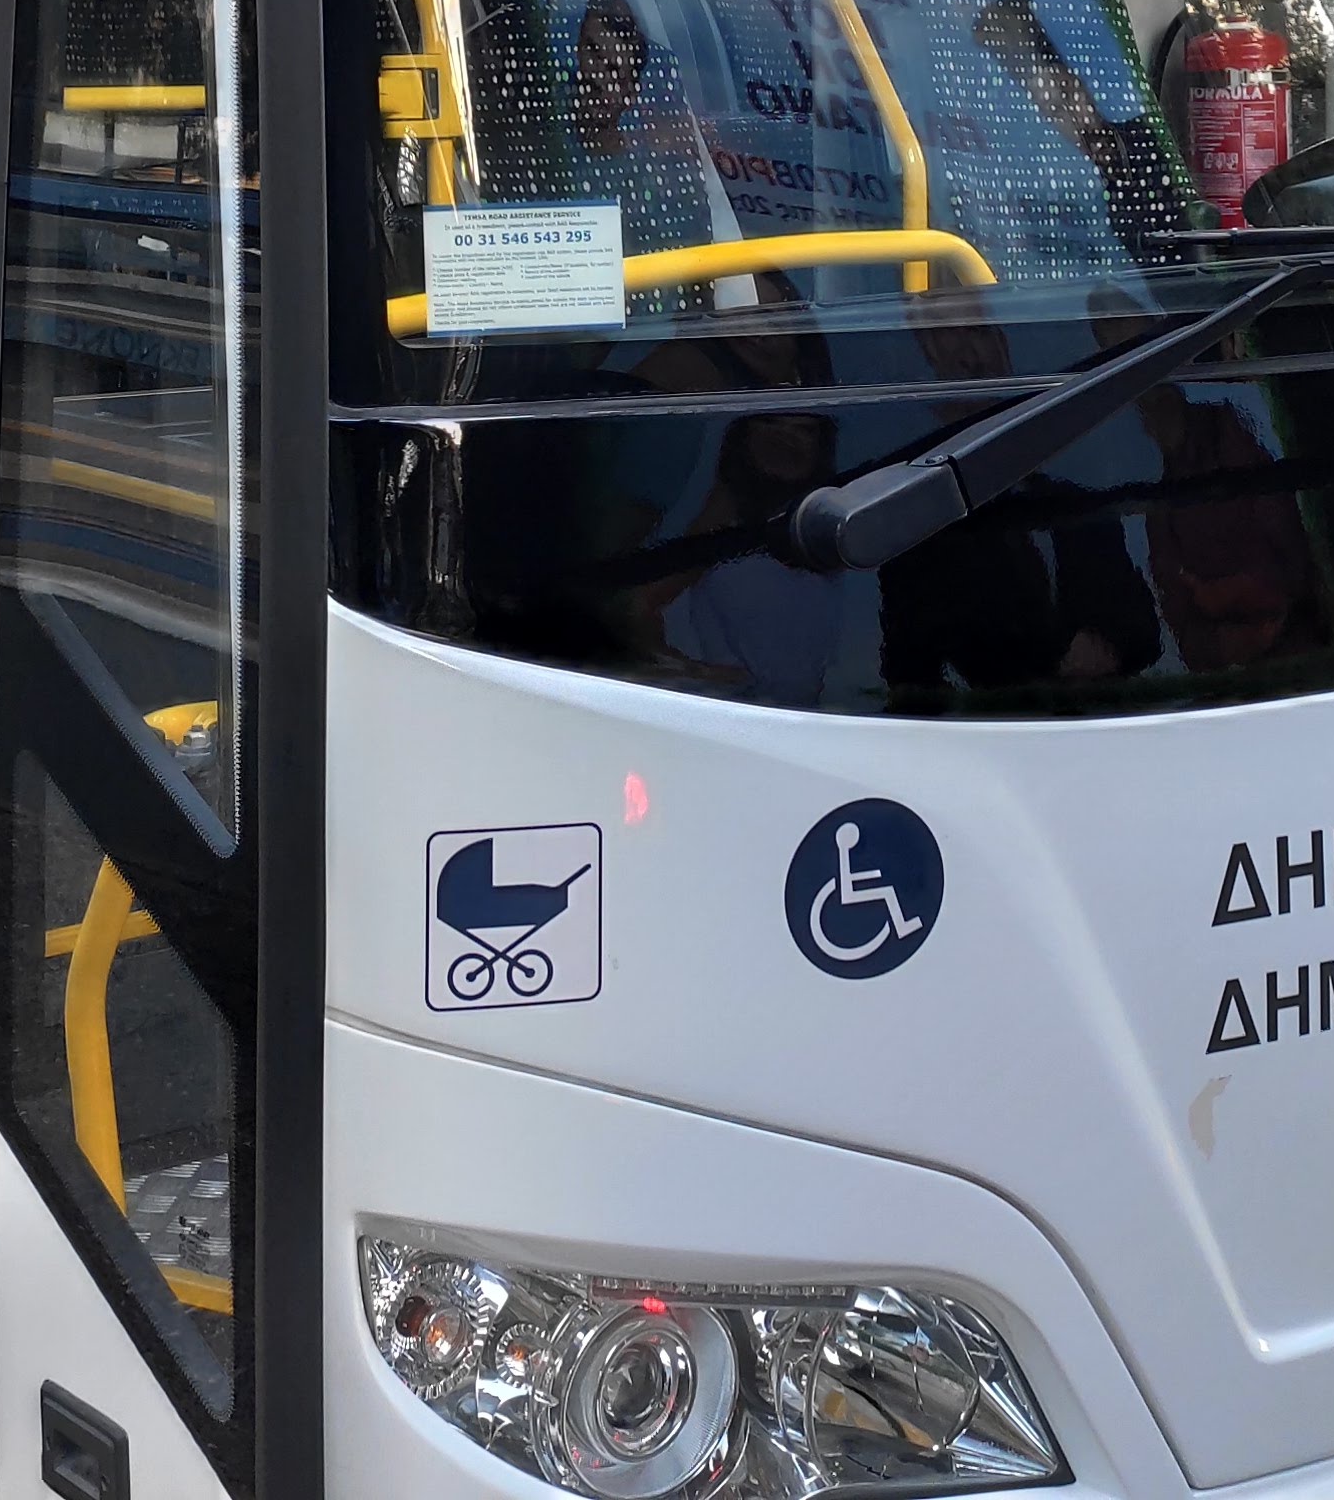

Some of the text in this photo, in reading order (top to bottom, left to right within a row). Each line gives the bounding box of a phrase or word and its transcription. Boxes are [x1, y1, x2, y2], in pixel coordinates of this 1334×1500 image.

[455, 230, 592, 247] 00 31 546 543 295
